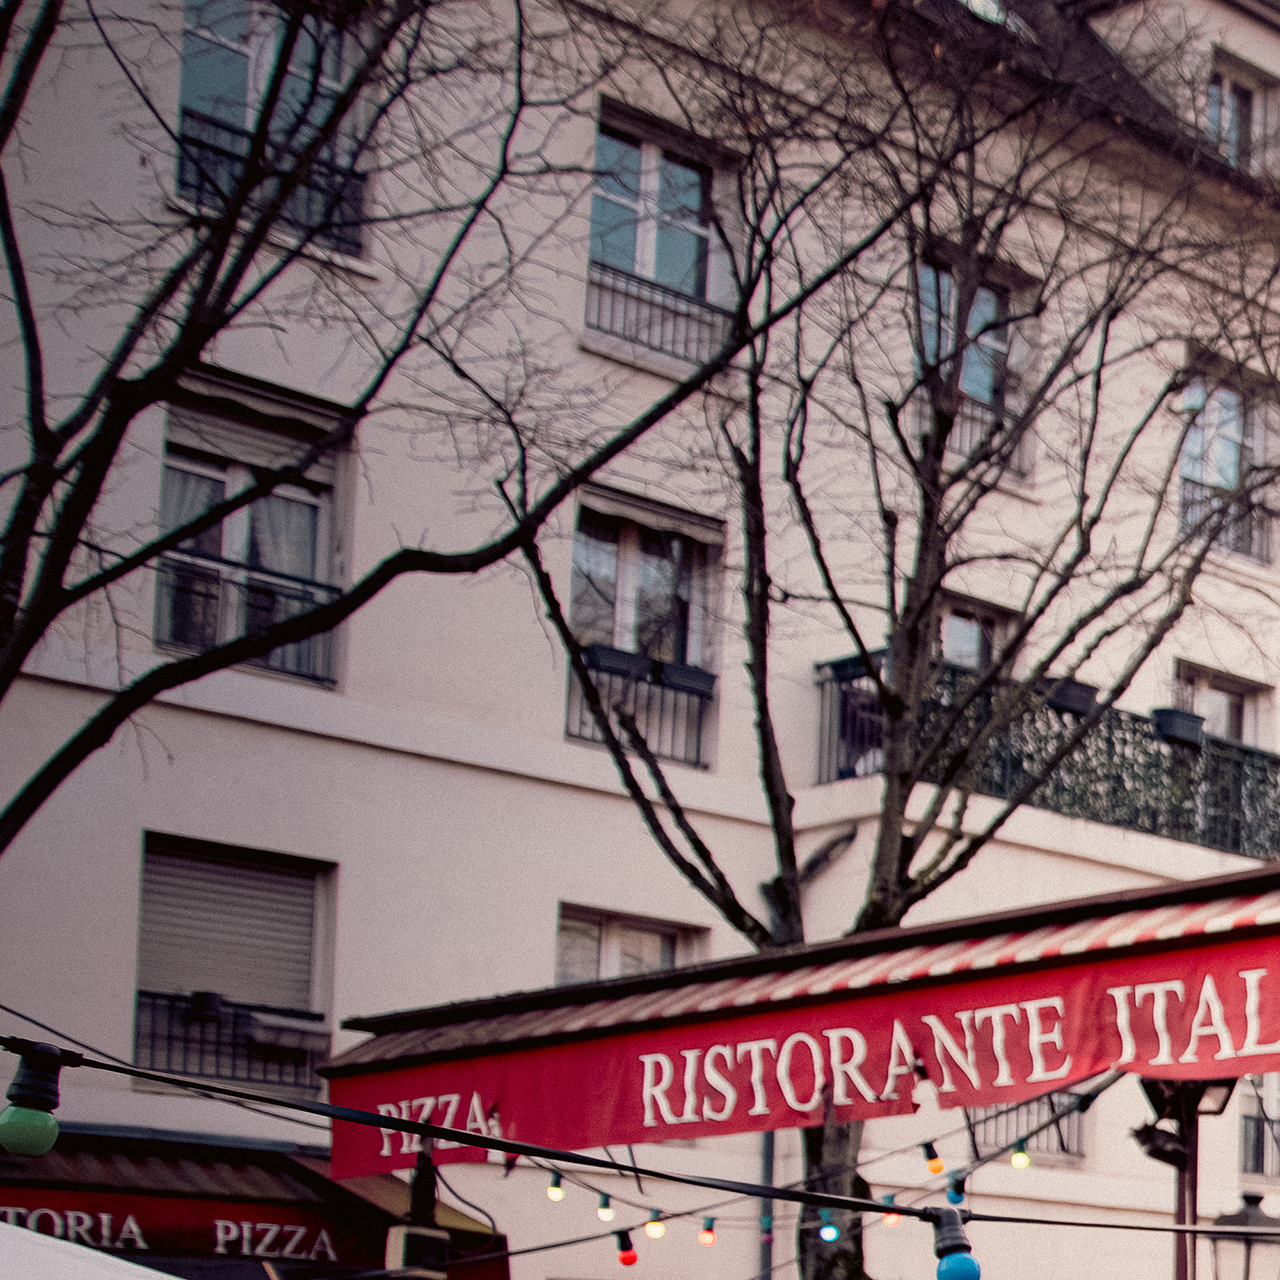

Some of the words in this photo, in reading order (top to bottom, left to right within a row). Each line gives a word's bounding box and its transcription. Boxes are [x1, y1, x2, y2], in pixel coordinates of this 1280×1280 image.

[638, 995, 1074, 1128] RISTORANTE
[376, 1091, 492, 1157] PIZZA
[213, 1219, 338, 1262] PIZZA
